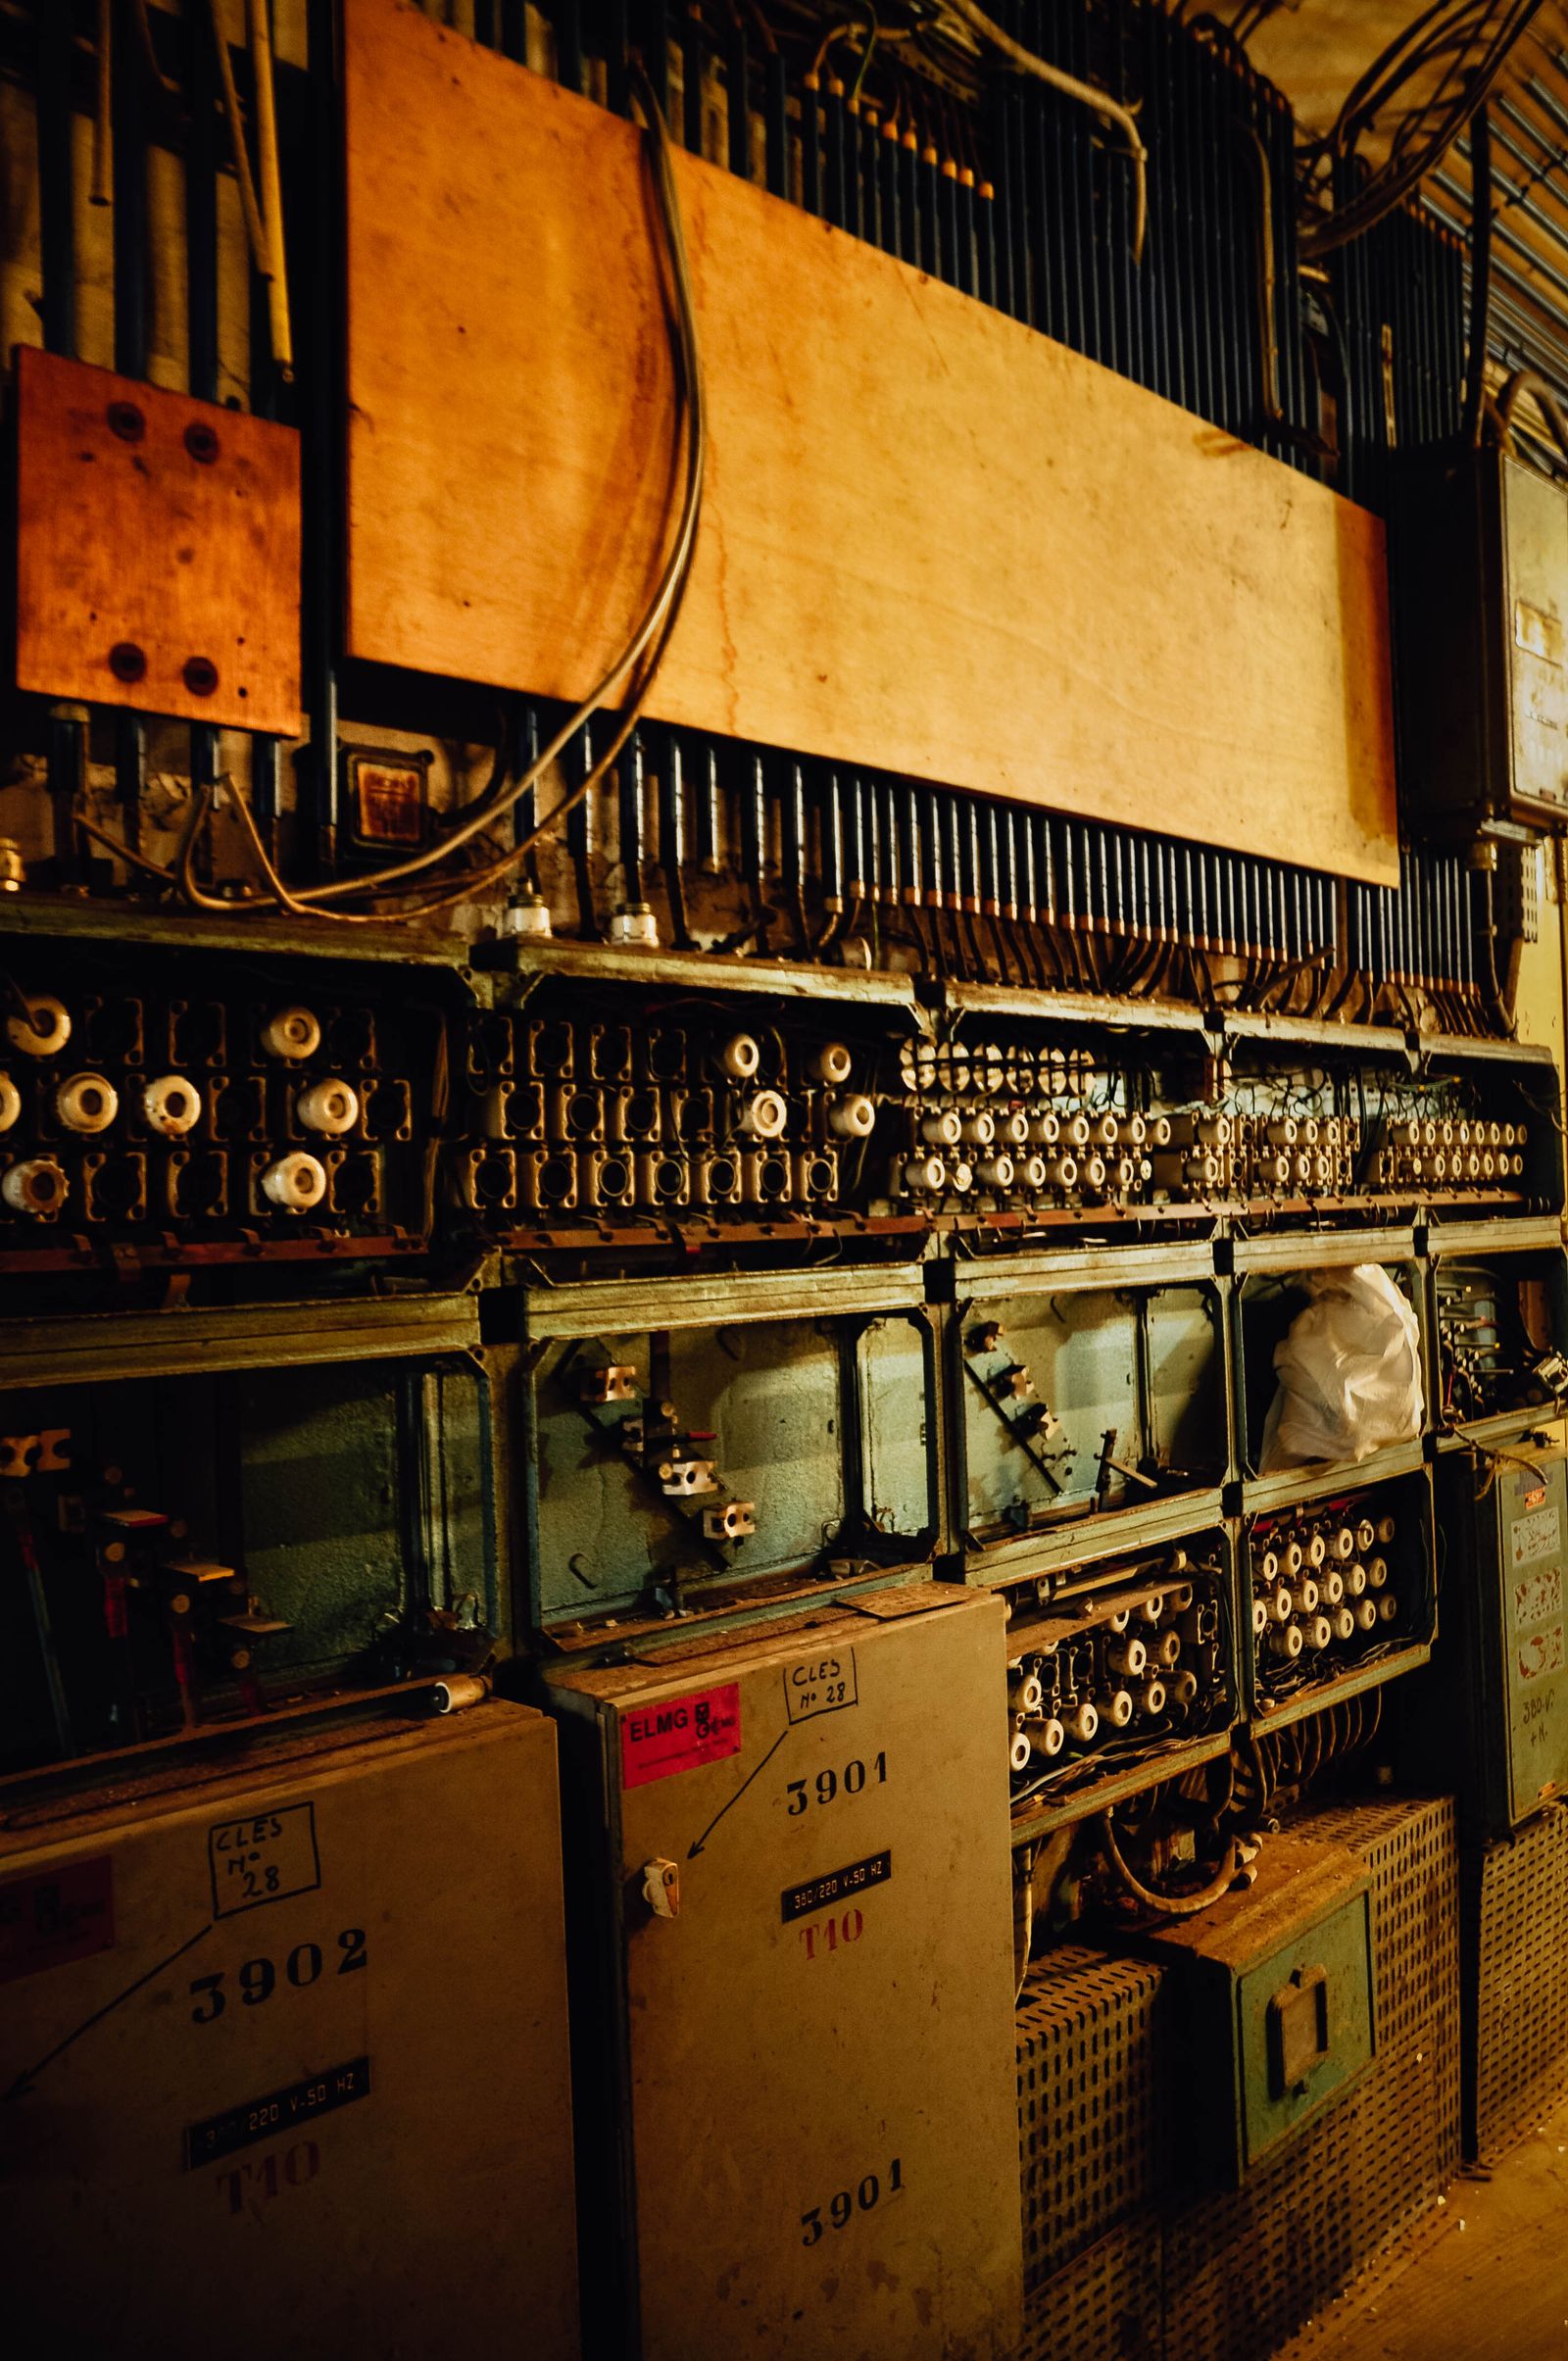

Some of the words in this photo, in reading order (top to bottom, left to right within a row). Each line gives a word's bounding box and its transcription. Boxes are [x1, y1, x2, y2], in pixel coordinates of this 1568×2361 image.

[792, 1659, 840, 1686] CLES
[827, 1682, 846, 1702] 28
[630, 1708, 688, 1742] ELMG
[786, 1751, 887, 1816] 3901
[216, 1816, 283, 1851] CLES
[243, 1866, 280, 1897] 28
[799, 1908, 863, 1960] T10
[190, 1928, 368, 2024] 3902
[217, 2141, 319, 2213] T10
[801, 2158, 902, 2246] 3901
